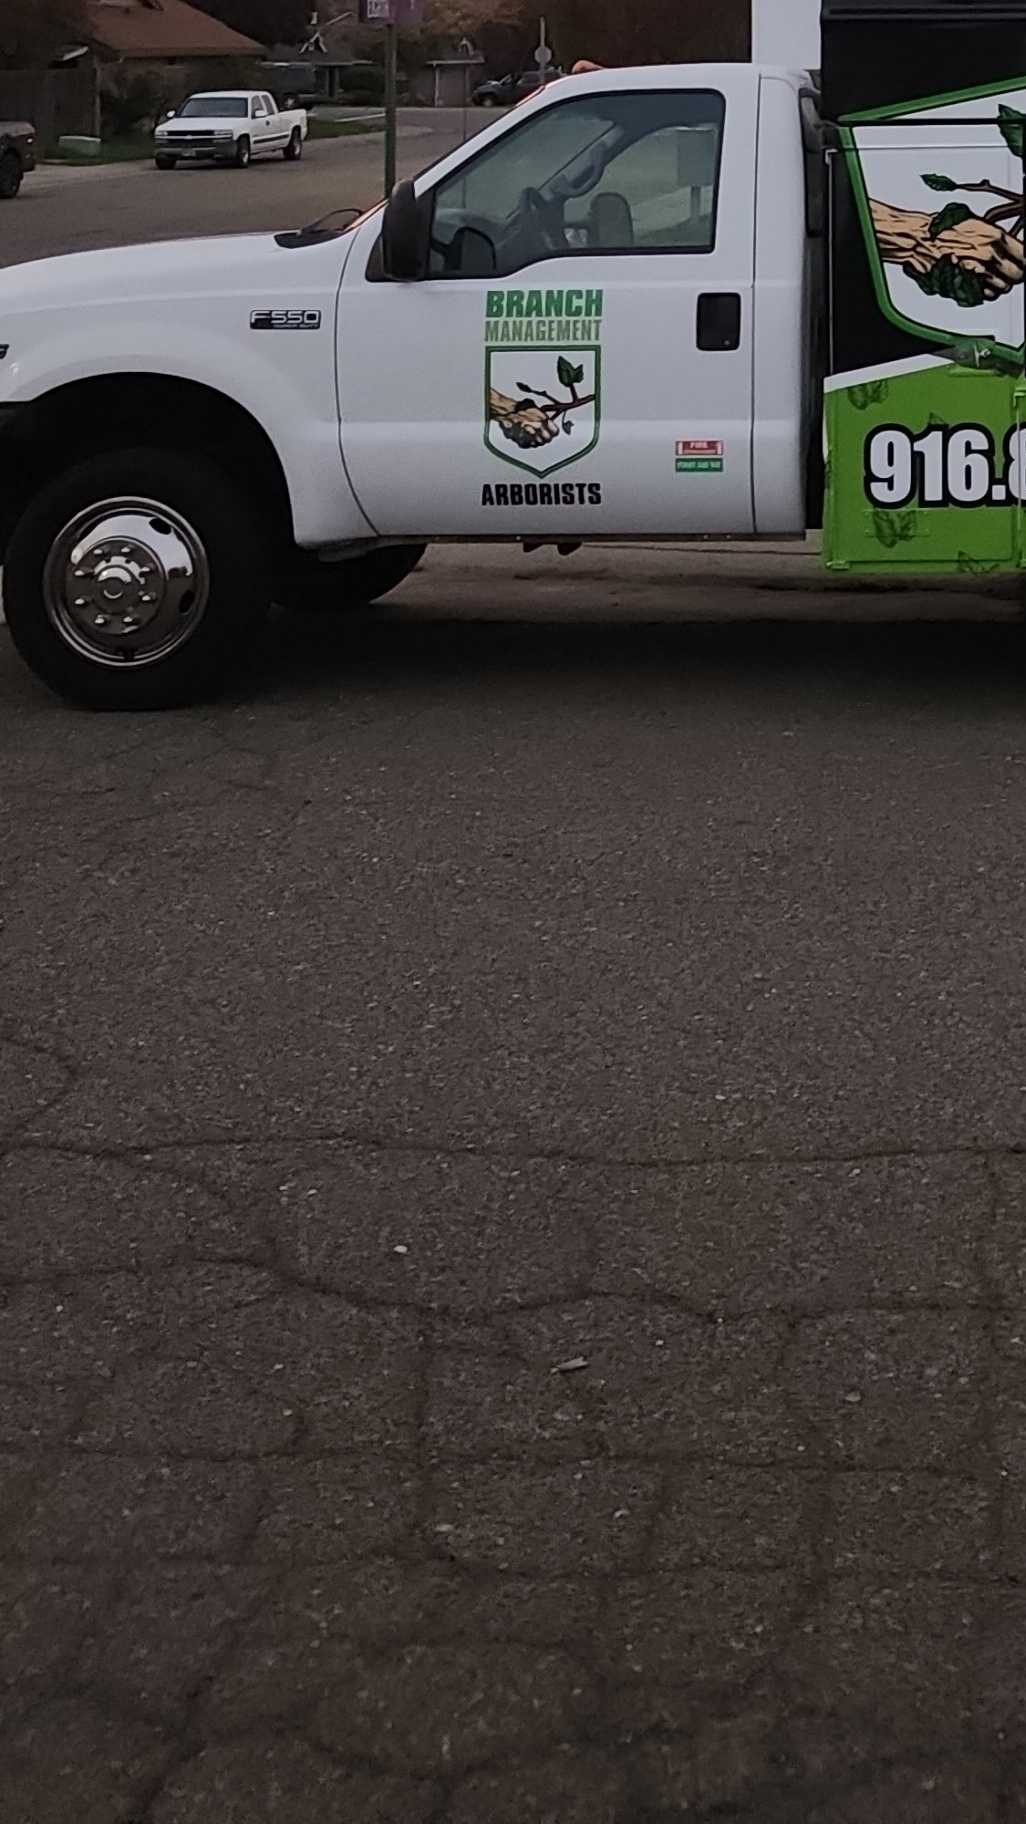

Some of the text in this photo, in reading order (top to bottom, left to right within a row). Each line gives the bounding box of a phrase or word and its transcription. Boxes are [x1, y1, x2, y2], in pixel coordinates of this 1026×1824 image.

[485, 289, 604, 318] BRANCH
[484, 319, 602, 343] MANAGEMENT
[481, 482, 602, 507] ARBORISTS
